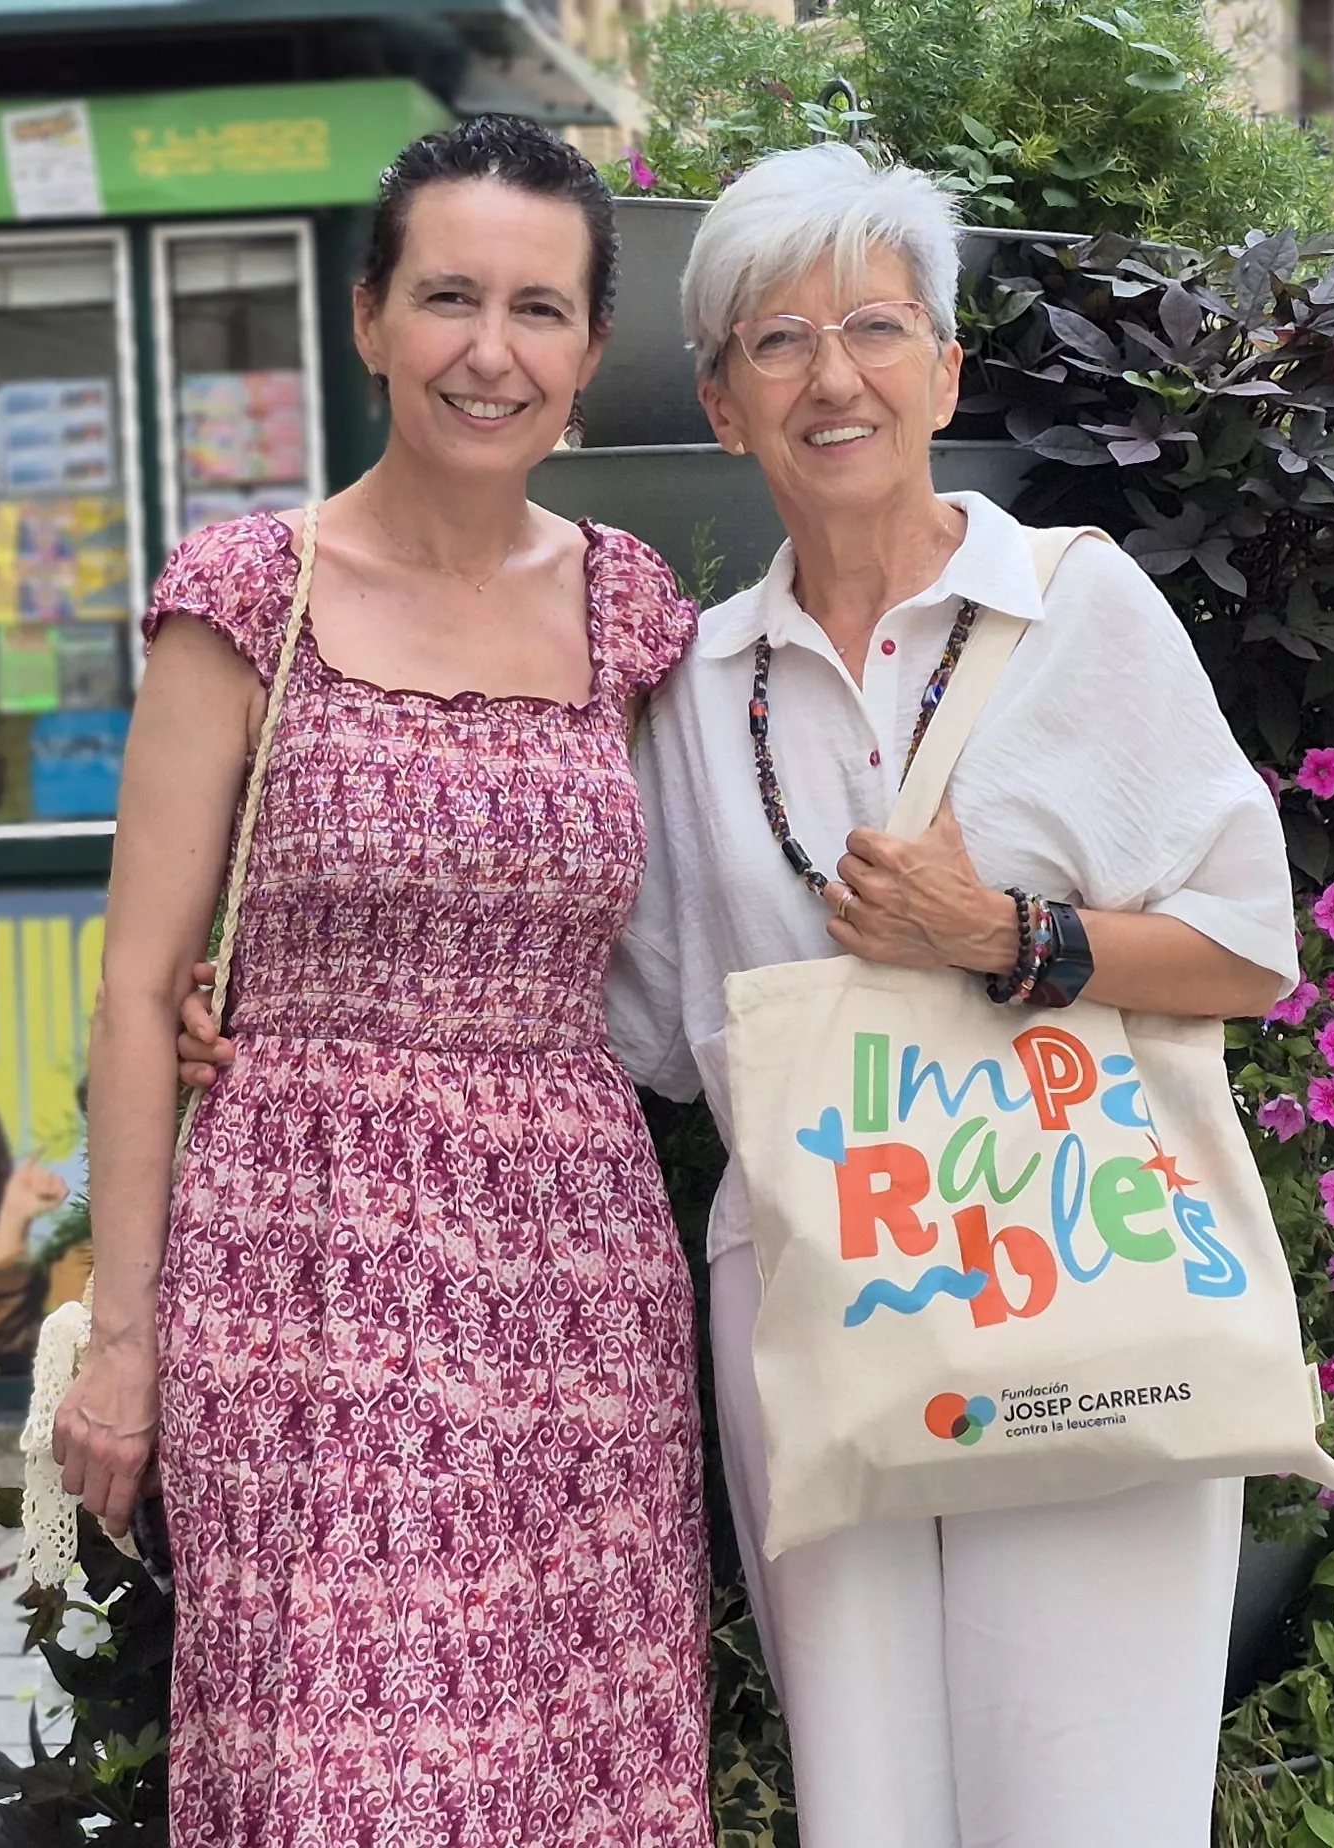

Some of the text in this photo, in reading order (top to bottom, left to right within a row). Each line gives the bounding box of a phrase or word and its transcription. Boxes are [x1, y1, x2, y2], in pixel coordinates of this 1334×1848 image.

[1001, 1382, 1068, 1402] Fundación
[1004, 1382, 1192, 1422] JOSEP CARRERAS
[1005, 1412, 1127, 1438] contra la leucemia
